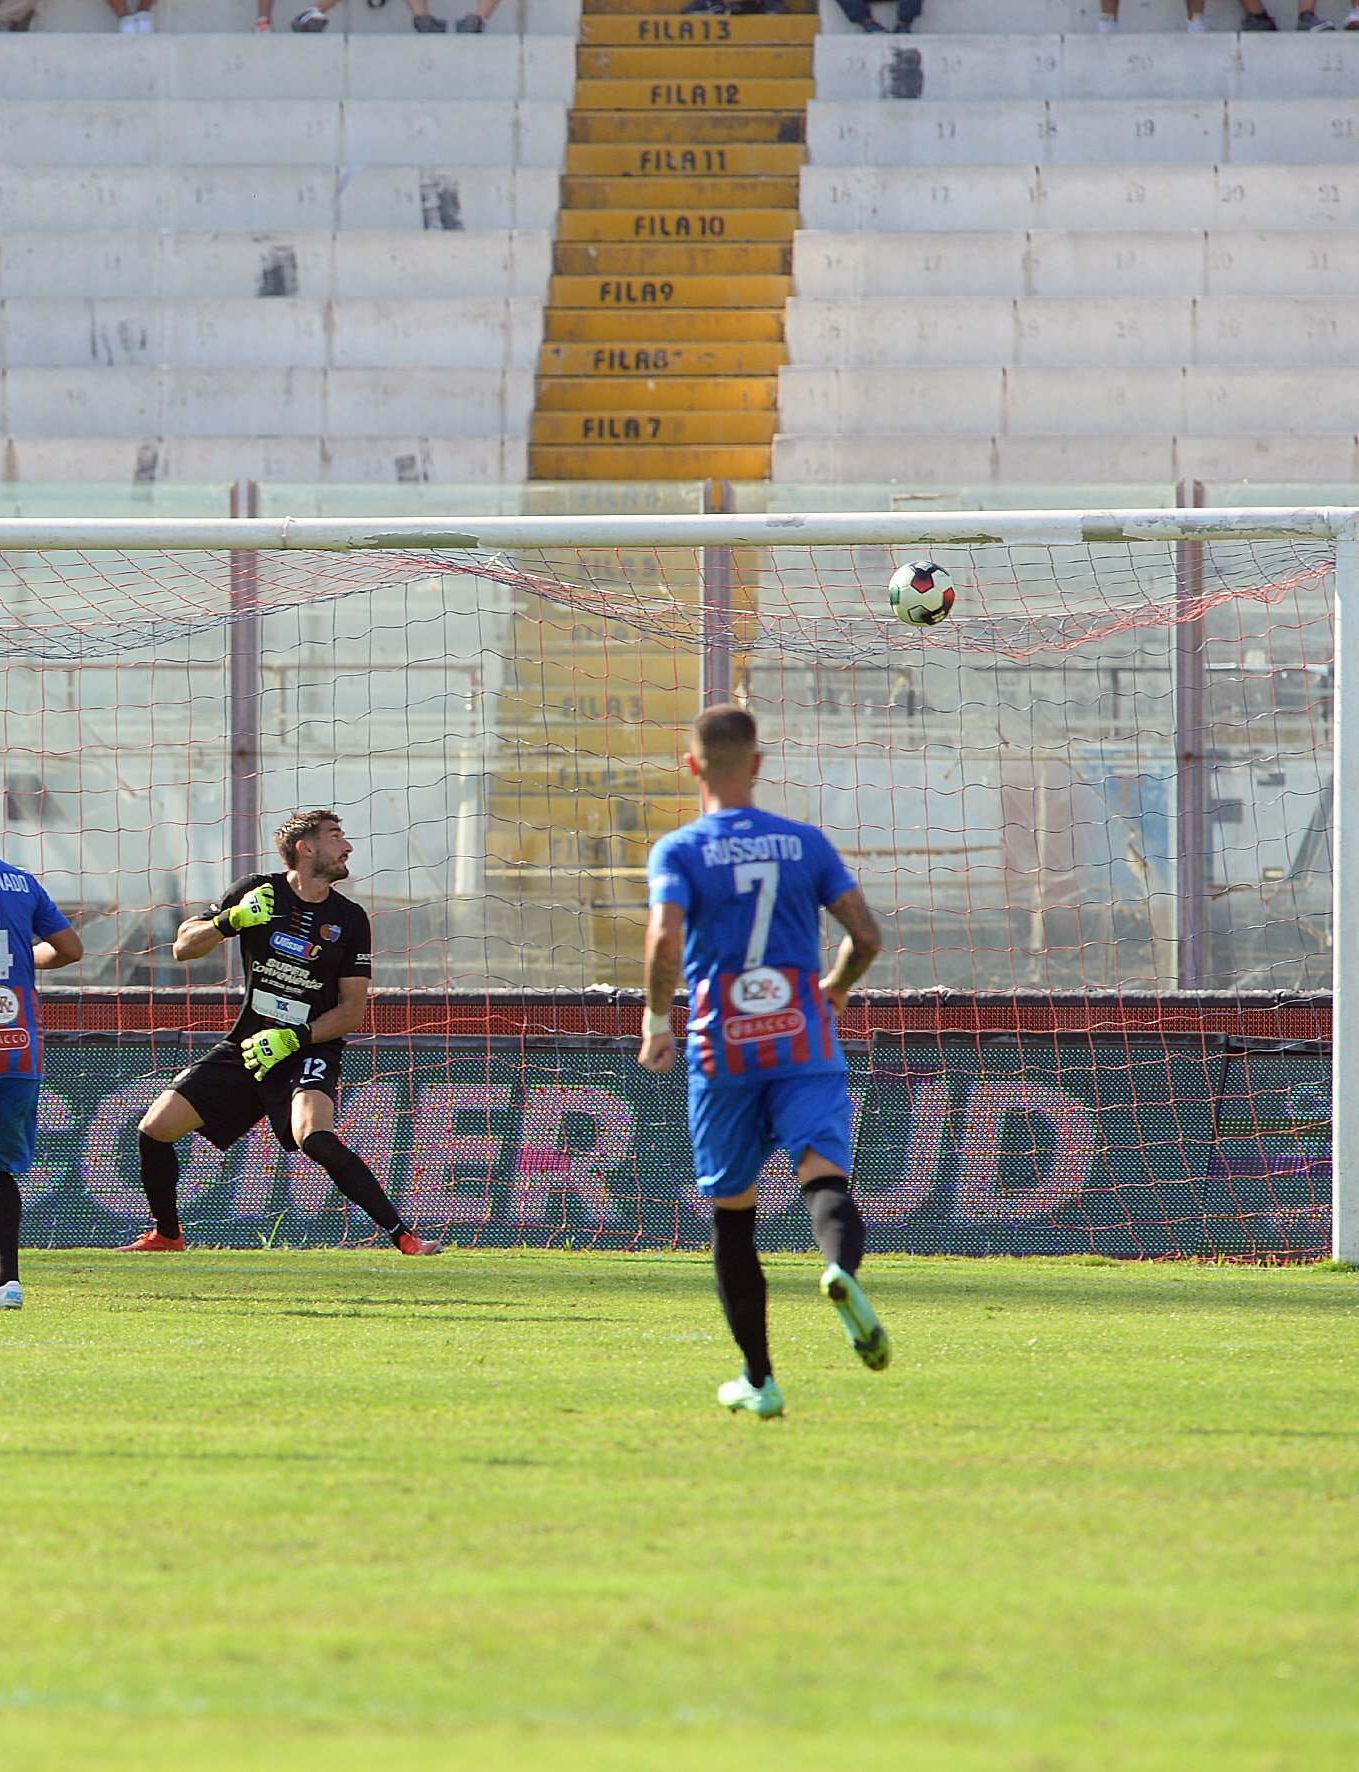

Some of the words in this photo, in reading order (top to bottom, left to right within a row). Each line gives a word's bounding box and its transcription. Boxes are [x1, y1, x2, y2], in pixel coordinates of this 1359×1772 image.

[638, 21, 696, 40] FILA
[702, 21, 731, 40] 13
[651, 85, 708, 105] FILA
[714, 85, 740, 105] 12
[1135, 118, 1156, 139] 19
[1331, 118, 1354, 139] 21
[640, 150, 697, 171] FILA
[702, 150, 727, 171] 11
[634, 216, 691, 236] FILA
[697, 216, 725, 236] 10
[582, 418, 640, 439] FILA
[647, 418, 661, 438] 7
[562, 695, 623, 718] FILA
[704, 834, 803, 867] RUSSOTTO
[734, 861, 779, 970] 7
[273, 935, 305, 952] Ulisse
[251, 960, 325, 991] Conveniente
[265, 957, 311, 979] SUPER
[302, 1057, 328, 1080] 12
